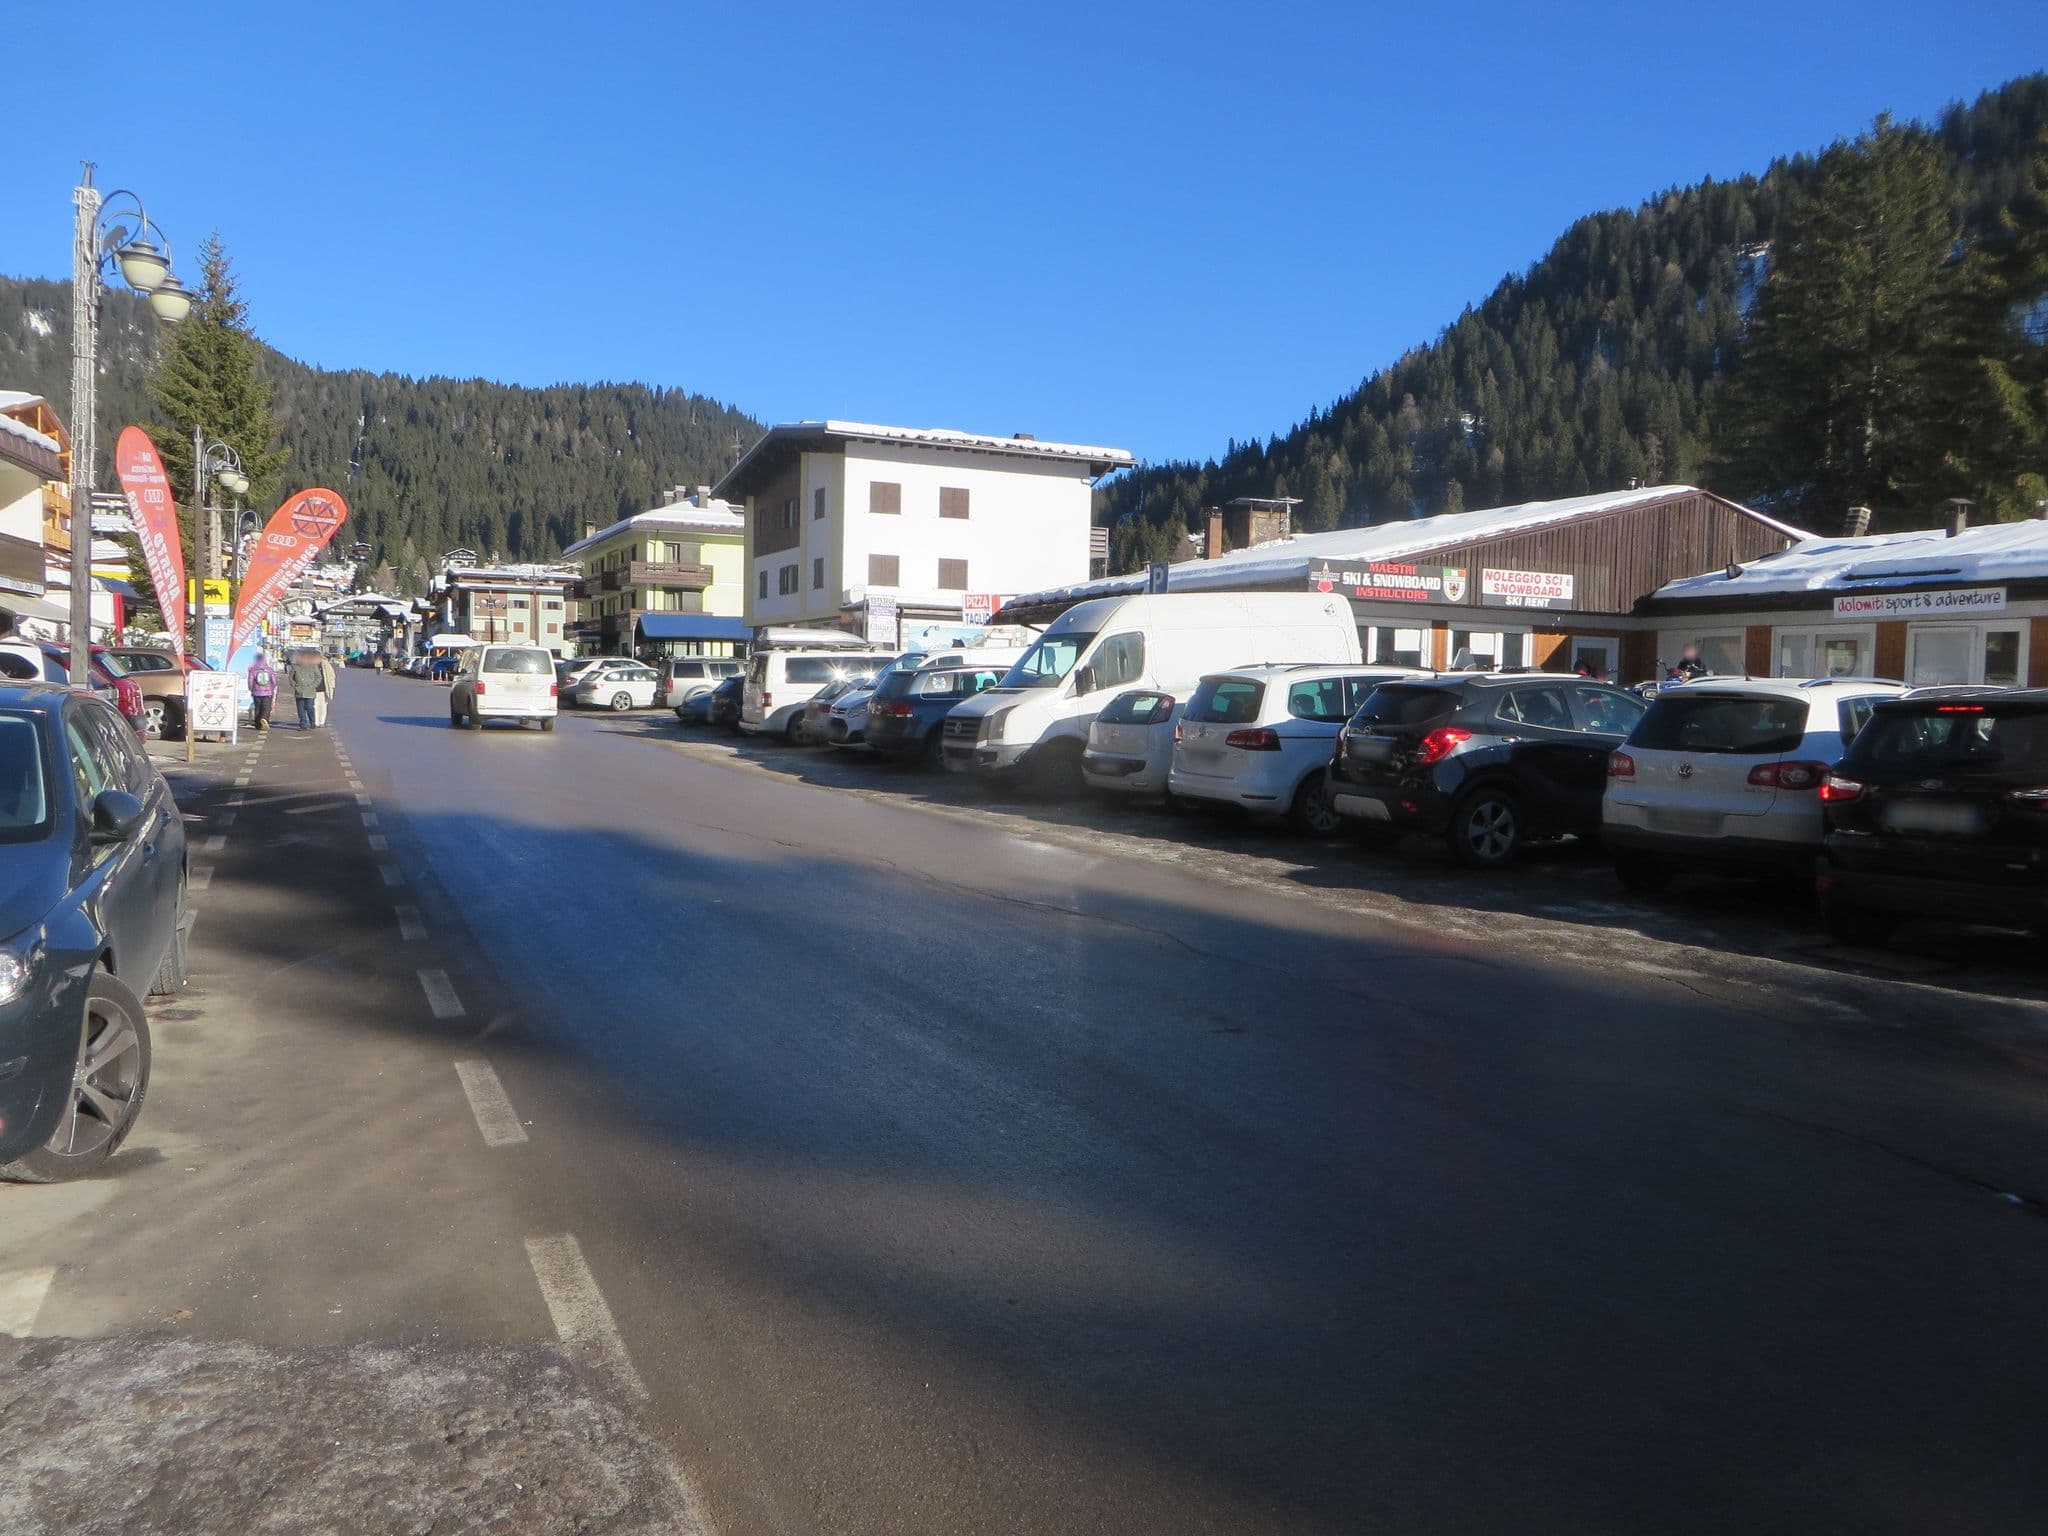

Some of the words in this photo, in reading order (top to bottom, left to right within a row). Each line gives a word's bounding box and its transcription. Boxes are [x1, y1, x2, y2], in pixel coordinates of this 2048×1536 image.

[277, 570, 296, 590] DES
[293, 543, 320, 572] ALPES
[1369, 564, 1416, 574] MAESTRI
[1153, 568, 1163, 592] P
[1342, 572, 1361, 585] SKI
[1362, 573, 1372, 586] &
[1374, 574, 1440, 590] SNOWBOARD
[1484, 570, 1542, 584] NOLEGGIO
[1545, 575, 1562, 586] SCI
[1355, 587, 1428, 600] INSTRUCTORS
[1494, 584, 1562, 596] SNOWBOARD
[966, 596, 988, 607] PIZZA
[1505, 596, 1522, 606] SKI
[1524, 598, 1551, 608] RENT
[1838, 597, 1884, 612] dolomiti
[1886, 595, 1922, 615] sport
[1935, 591, 2000, 607] adventure
